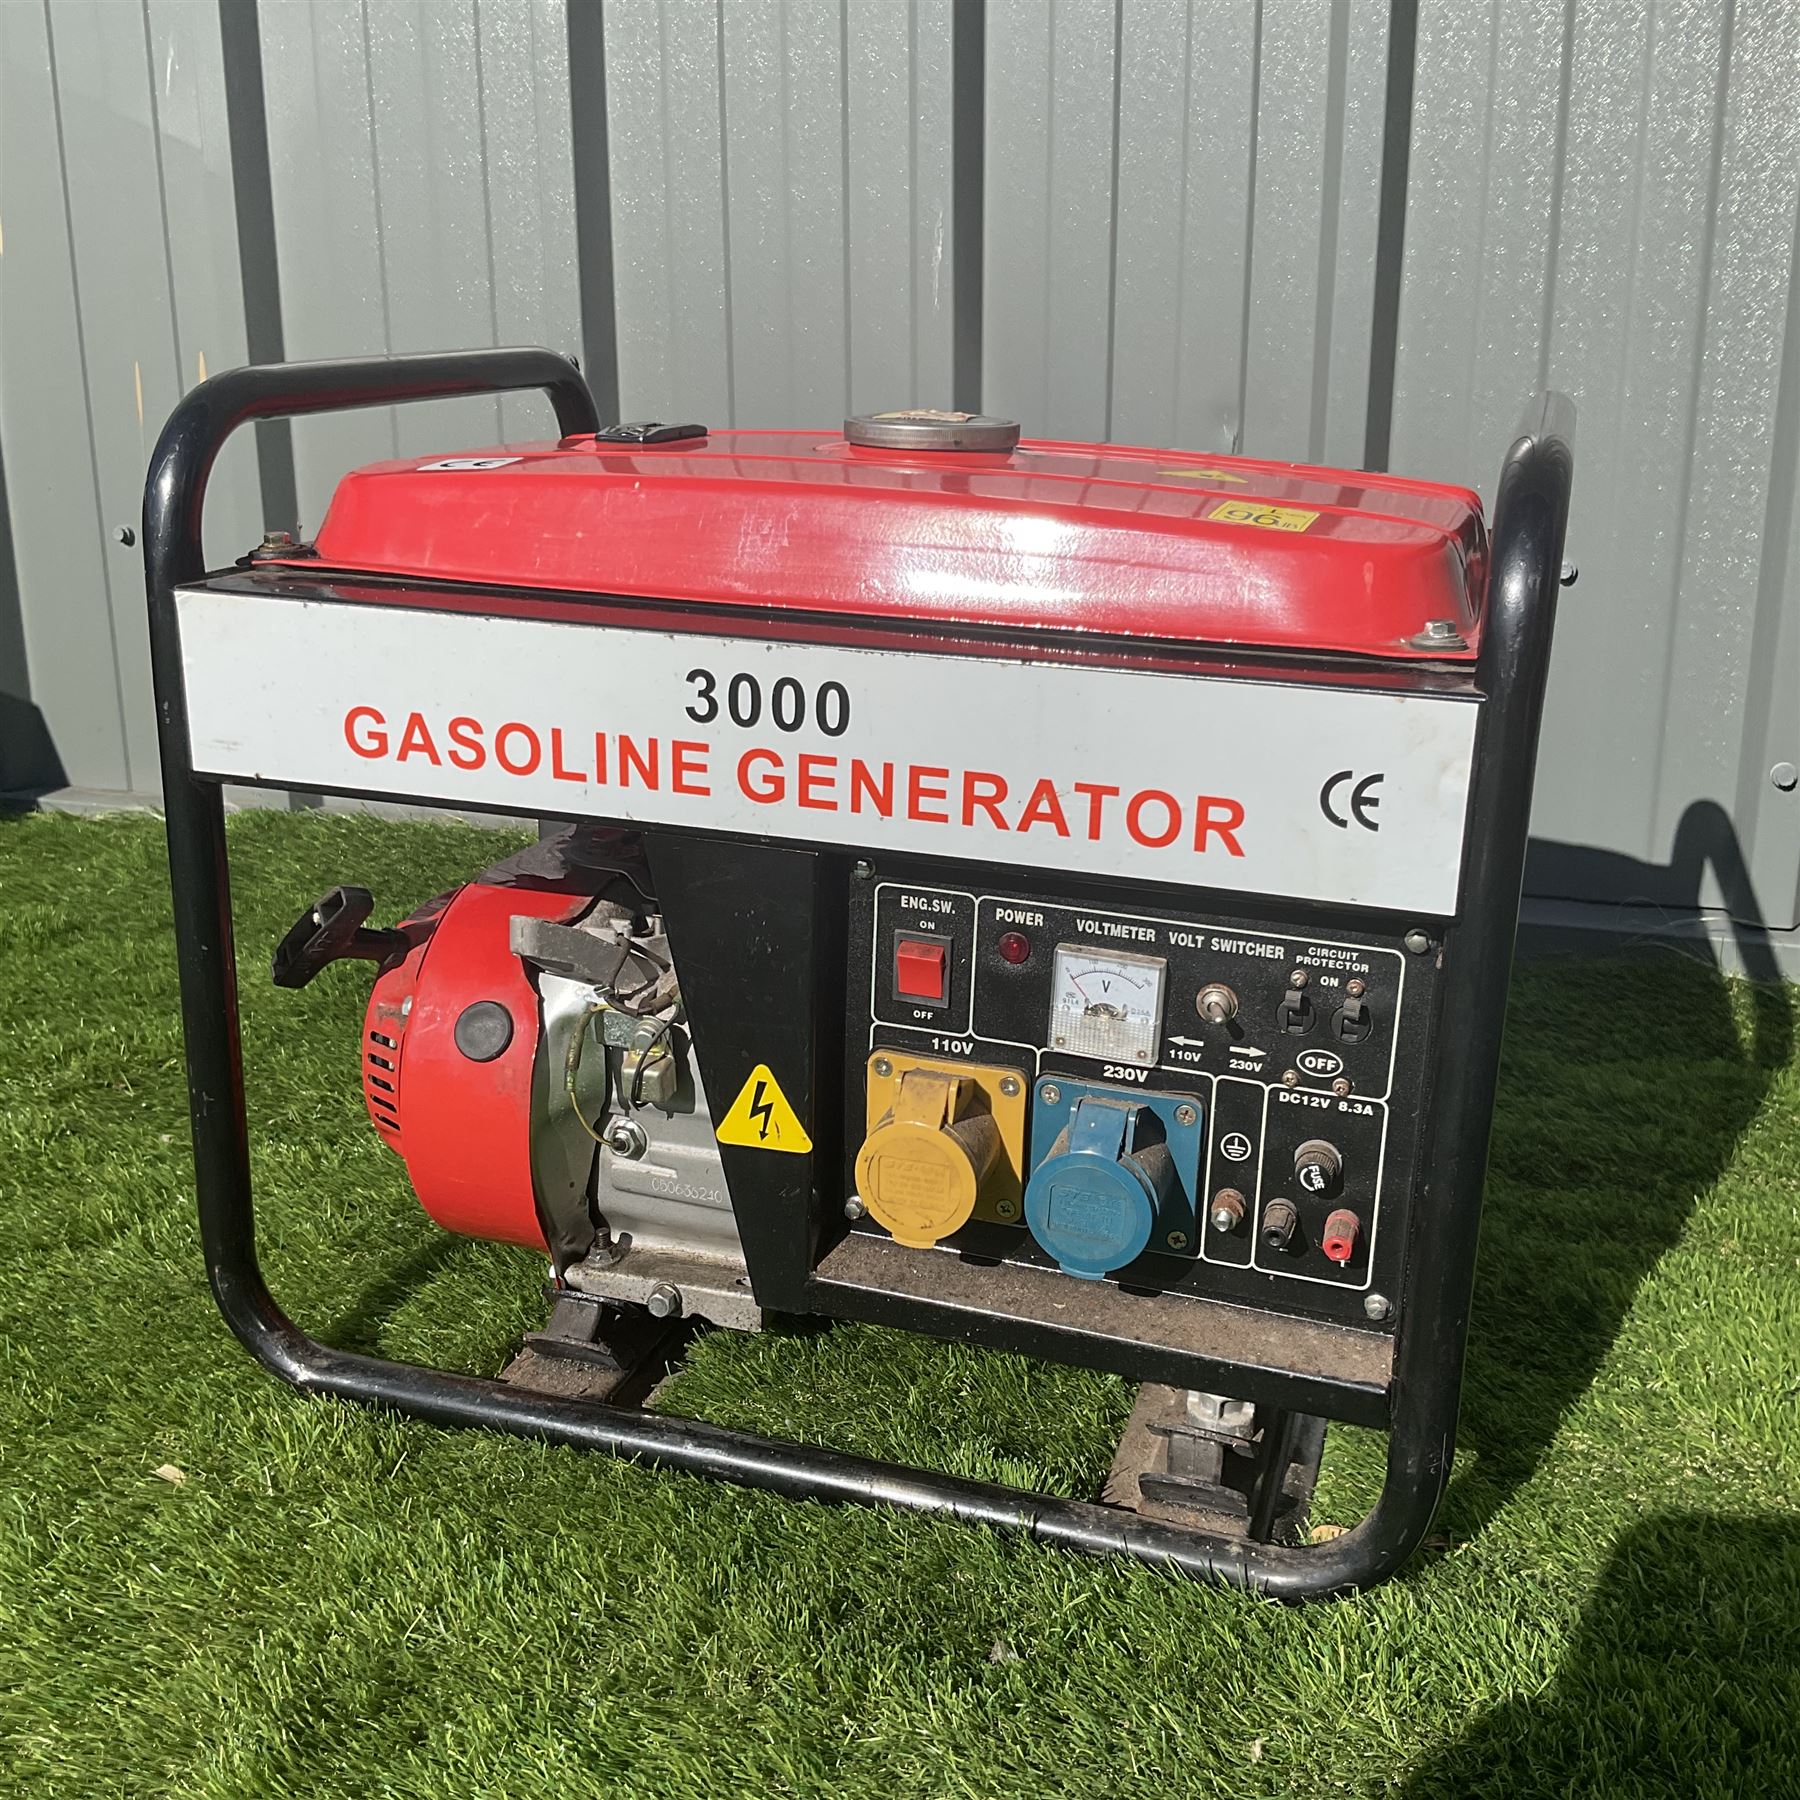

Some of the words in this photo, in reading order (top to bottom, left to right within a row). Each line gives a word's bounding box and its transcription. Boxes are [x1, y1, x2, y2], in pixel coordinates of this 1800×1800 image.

[1224, 509, 1281, 525] 96
[686, 669, 850, 737] 3000
[344, 706, 710, 796] GASOLINE
[737, 748, 1244, 856] GENERATOR
[1320, 770, 1385, 832] CE
[901, 895, 956, 915] ENG.SW.
[919, 920, 935, 930] ON
[995, 908, 1044, 927] POWER
[1076, 919, 1156, 942] VOLTMETER
[1169, 931, 1205, 949] VOLT
[1210, 938, 1285, 960] SWITCHER
[1308, 946, 1360, 961] CIRCUIT
[1295, 955, 1370, 974] PROTECTOR
[1102, 979, 1111, 993] V
[1319, 975, 1340, 988] ON
[913, 1010, 934, 1020] OFF
[931, 1037, 974, 1055] 110V
[1169, 1049, 1202, 1062] 110V
[1103, 1064, 1149, 1083] 230V
[1229, 1059, 1264, 1073] 230V
[1304, 1061, 1337, 1072] OFF
[1279, 1091, 1330, 1109] DC12V
[1338, 1101, 1374, 1116] 8.3A
[1308, 1165, 1325, 1190] FUSE
